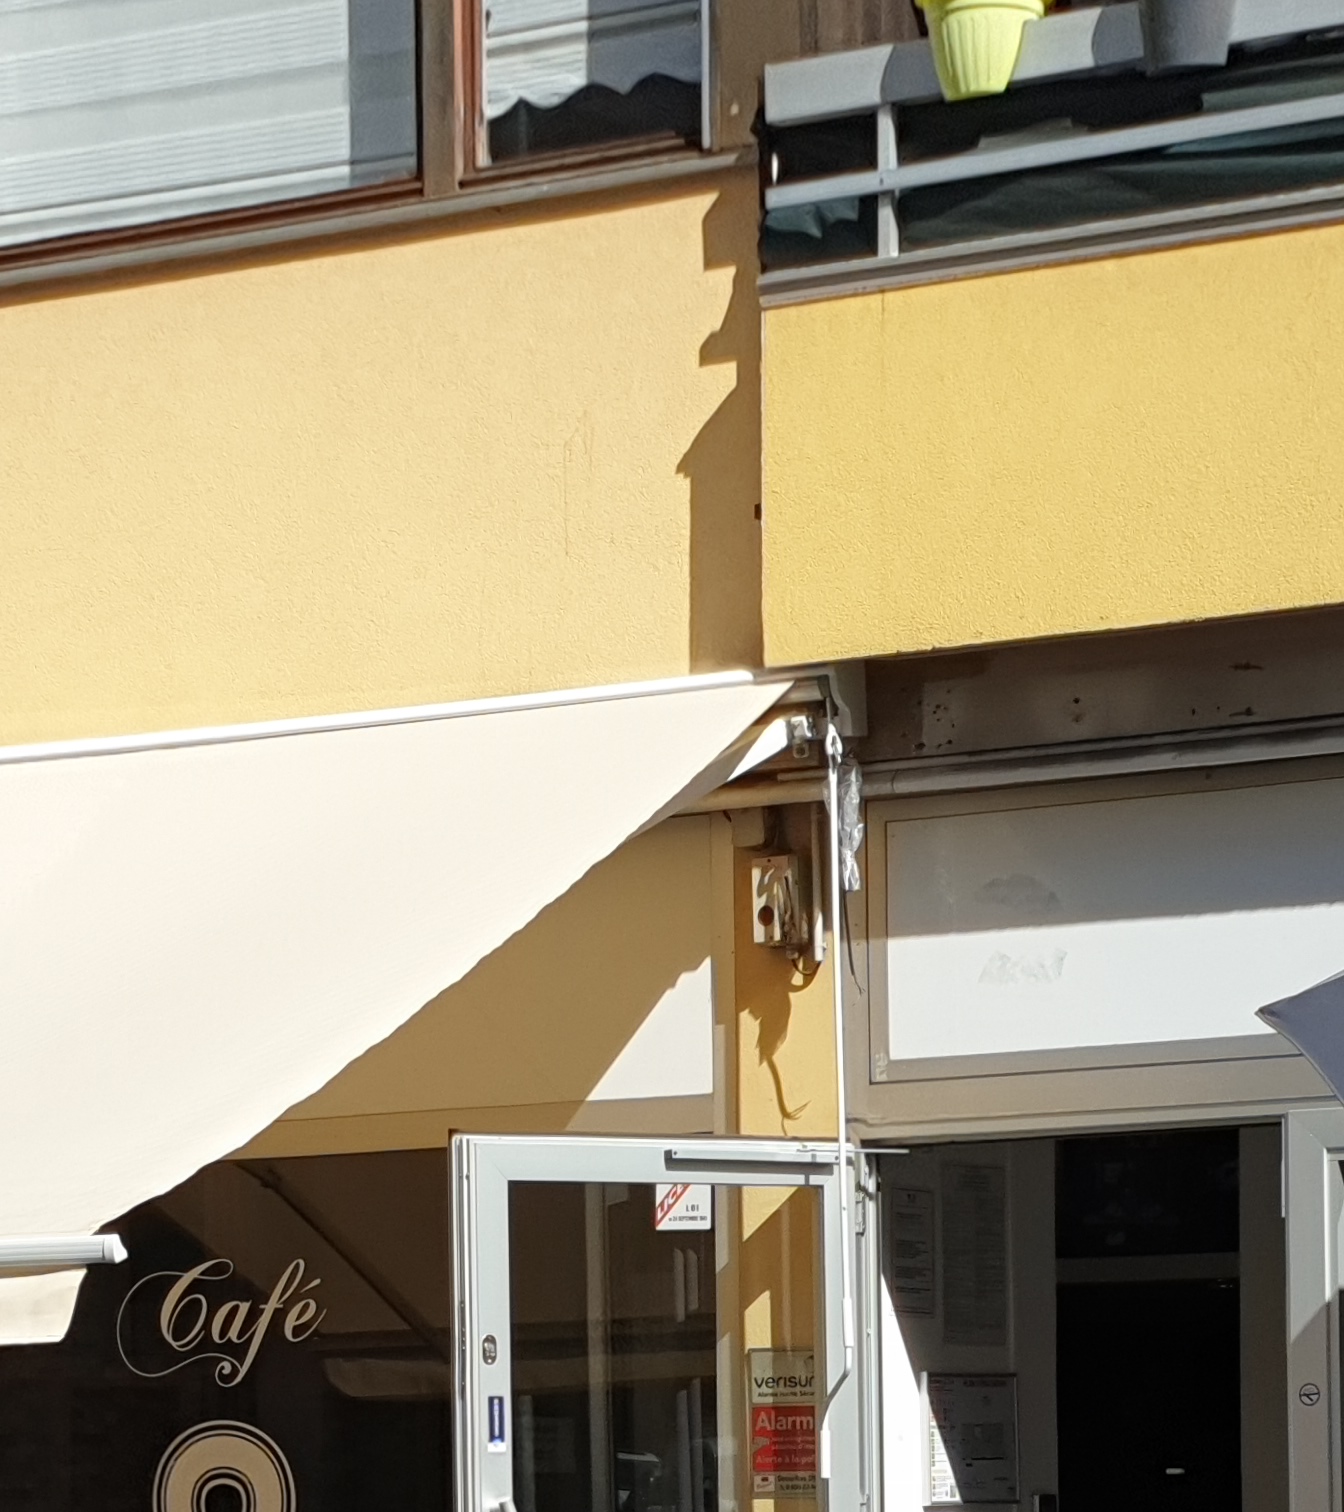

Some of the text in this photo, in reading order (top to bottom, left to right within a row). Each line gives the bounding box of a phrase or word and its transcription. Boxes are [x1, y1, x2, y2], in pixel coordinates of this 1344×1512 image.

[686, 1204, 699, 1212] LOI
[116, 1258, 326, 1387] Café
[754, 1375, 814, 1388] verisur
[755, 1410, 814, 1431] Alarm
